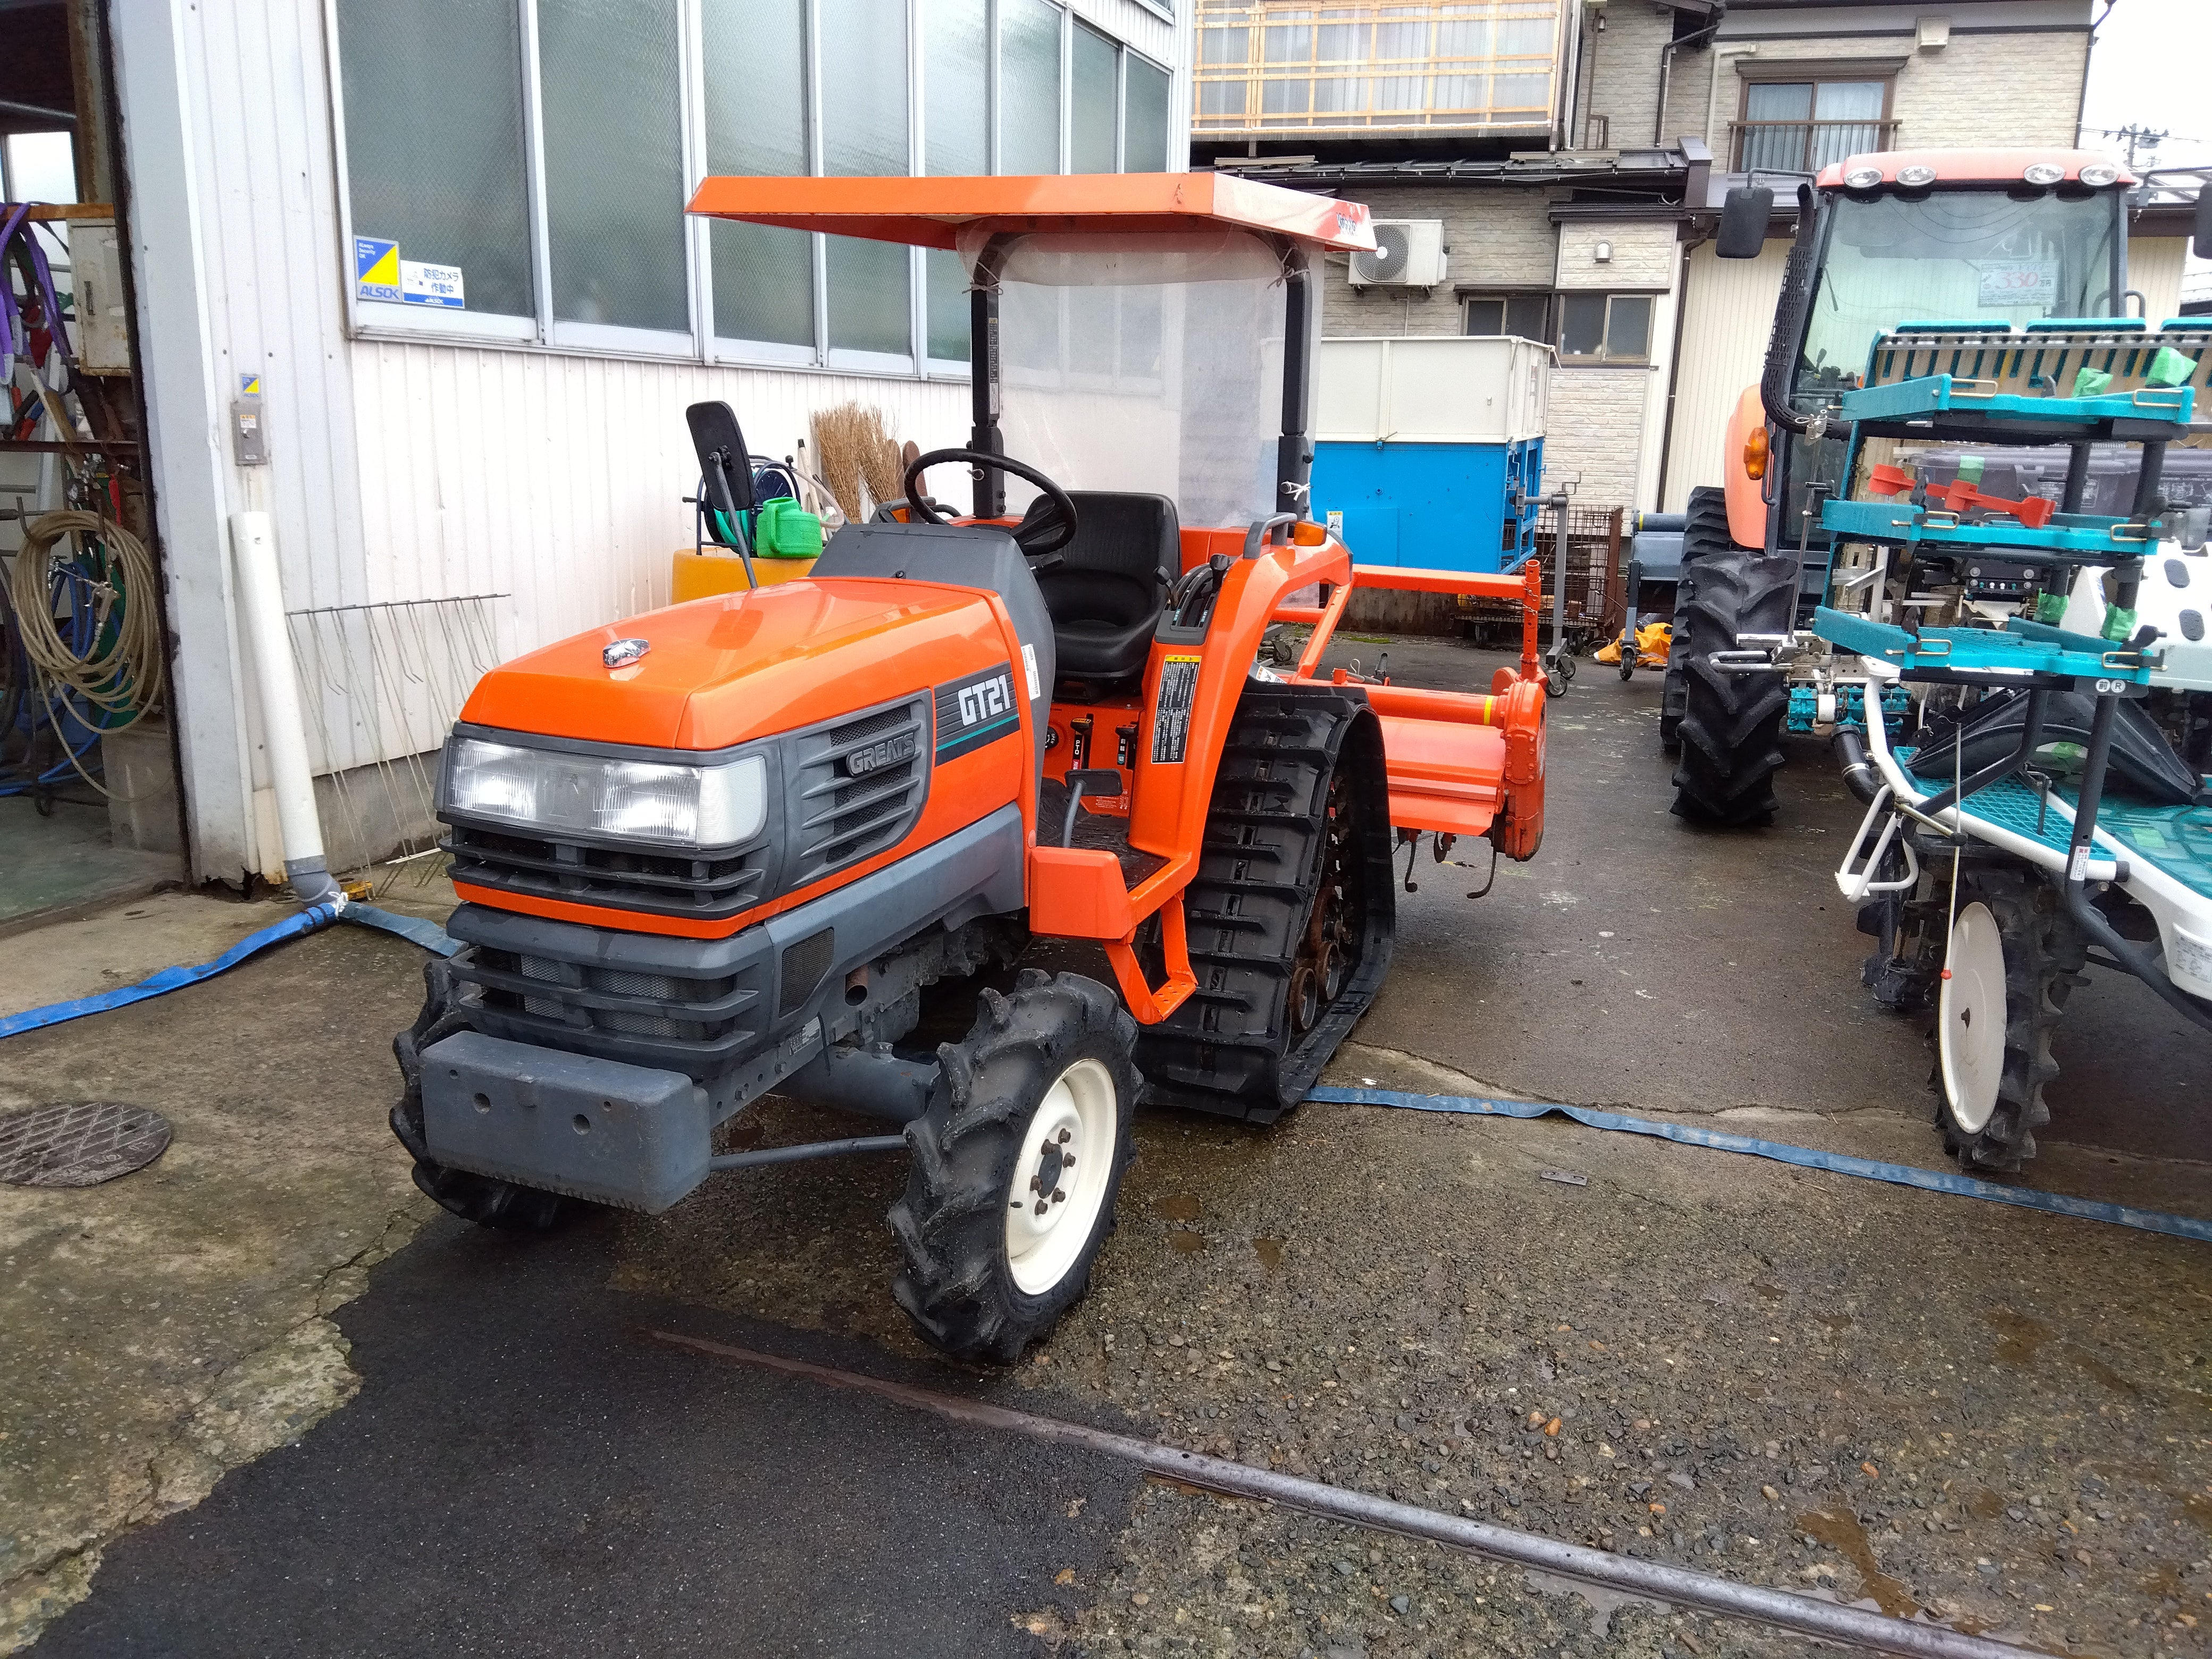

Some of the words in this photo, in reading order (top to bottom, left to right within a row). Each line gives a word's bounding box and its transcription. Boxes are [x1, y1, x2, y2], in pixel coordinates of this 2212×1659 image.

[423, 268, 459, 282] 防犯カメラ
[1995, 272, 2039, 289] 330
[360, 286, 399, 300] ALSOK
[431, 282, 454, 294] 作動中
[958, 674, 1010, 726] GT21
[851, 733, 916, 775] GREATS
